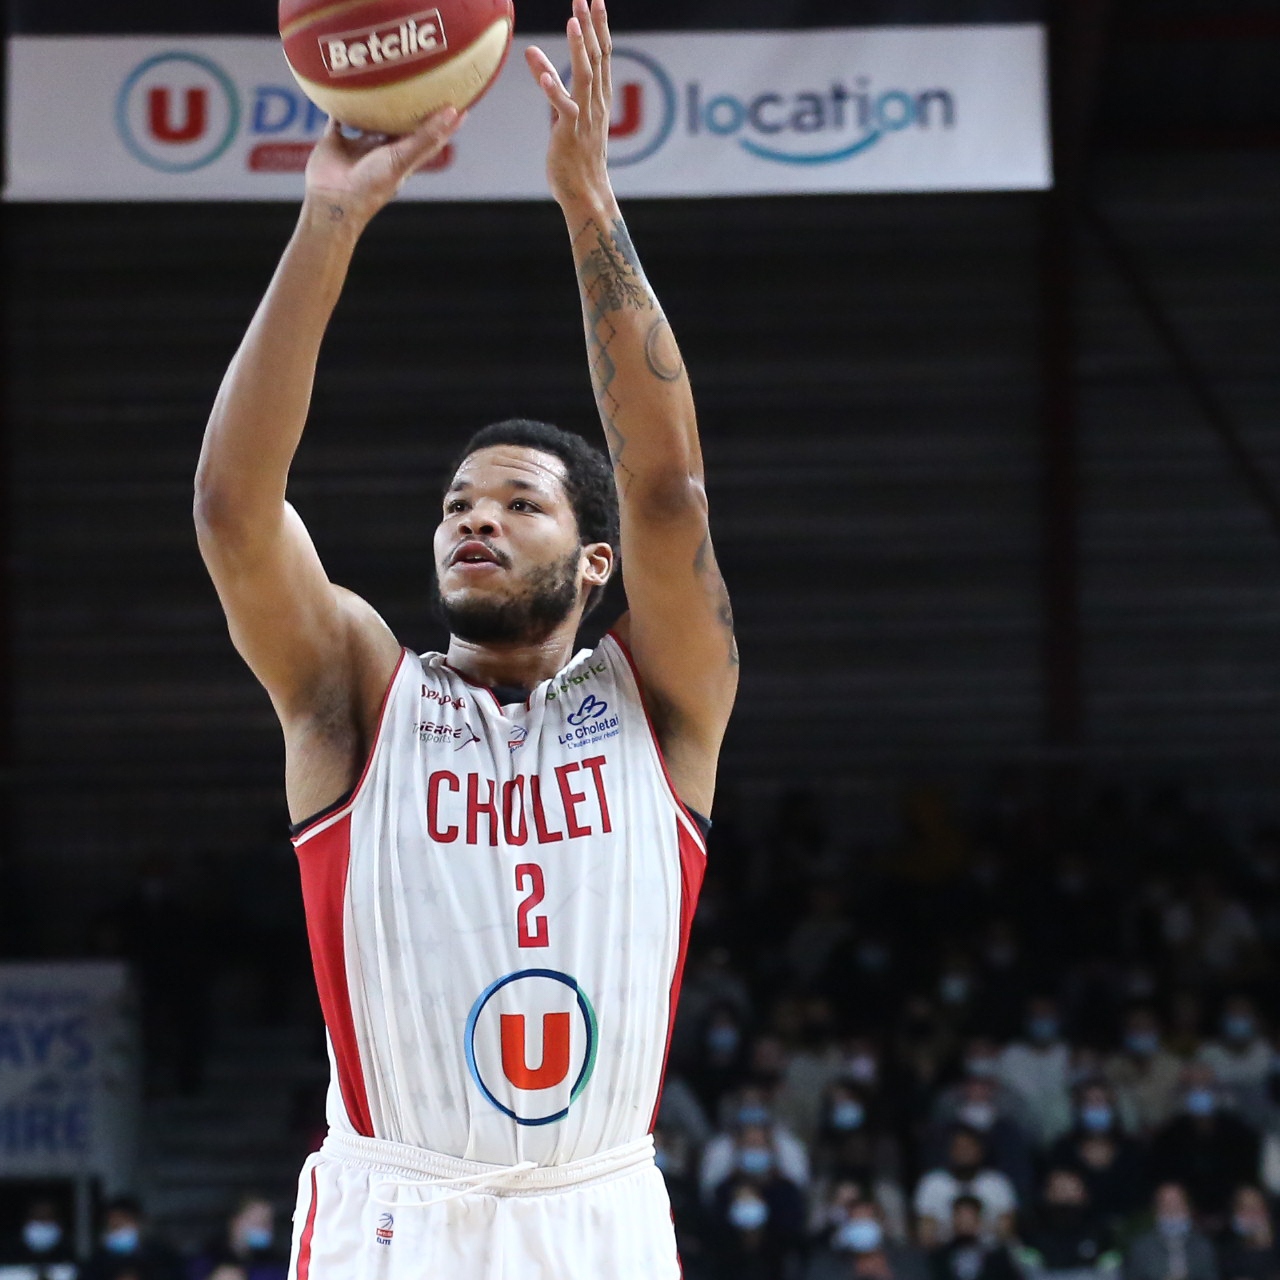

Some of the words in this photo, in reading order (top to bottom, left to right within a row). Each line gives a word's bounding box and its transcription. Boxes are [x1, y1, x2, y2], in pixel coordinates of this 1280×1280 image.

[328, 19, 437, 71] Betclic
[686, 77, 956, 135] location
[426, 755, 613, 847] CHOLET
[515, 863, 550, 949] 2
